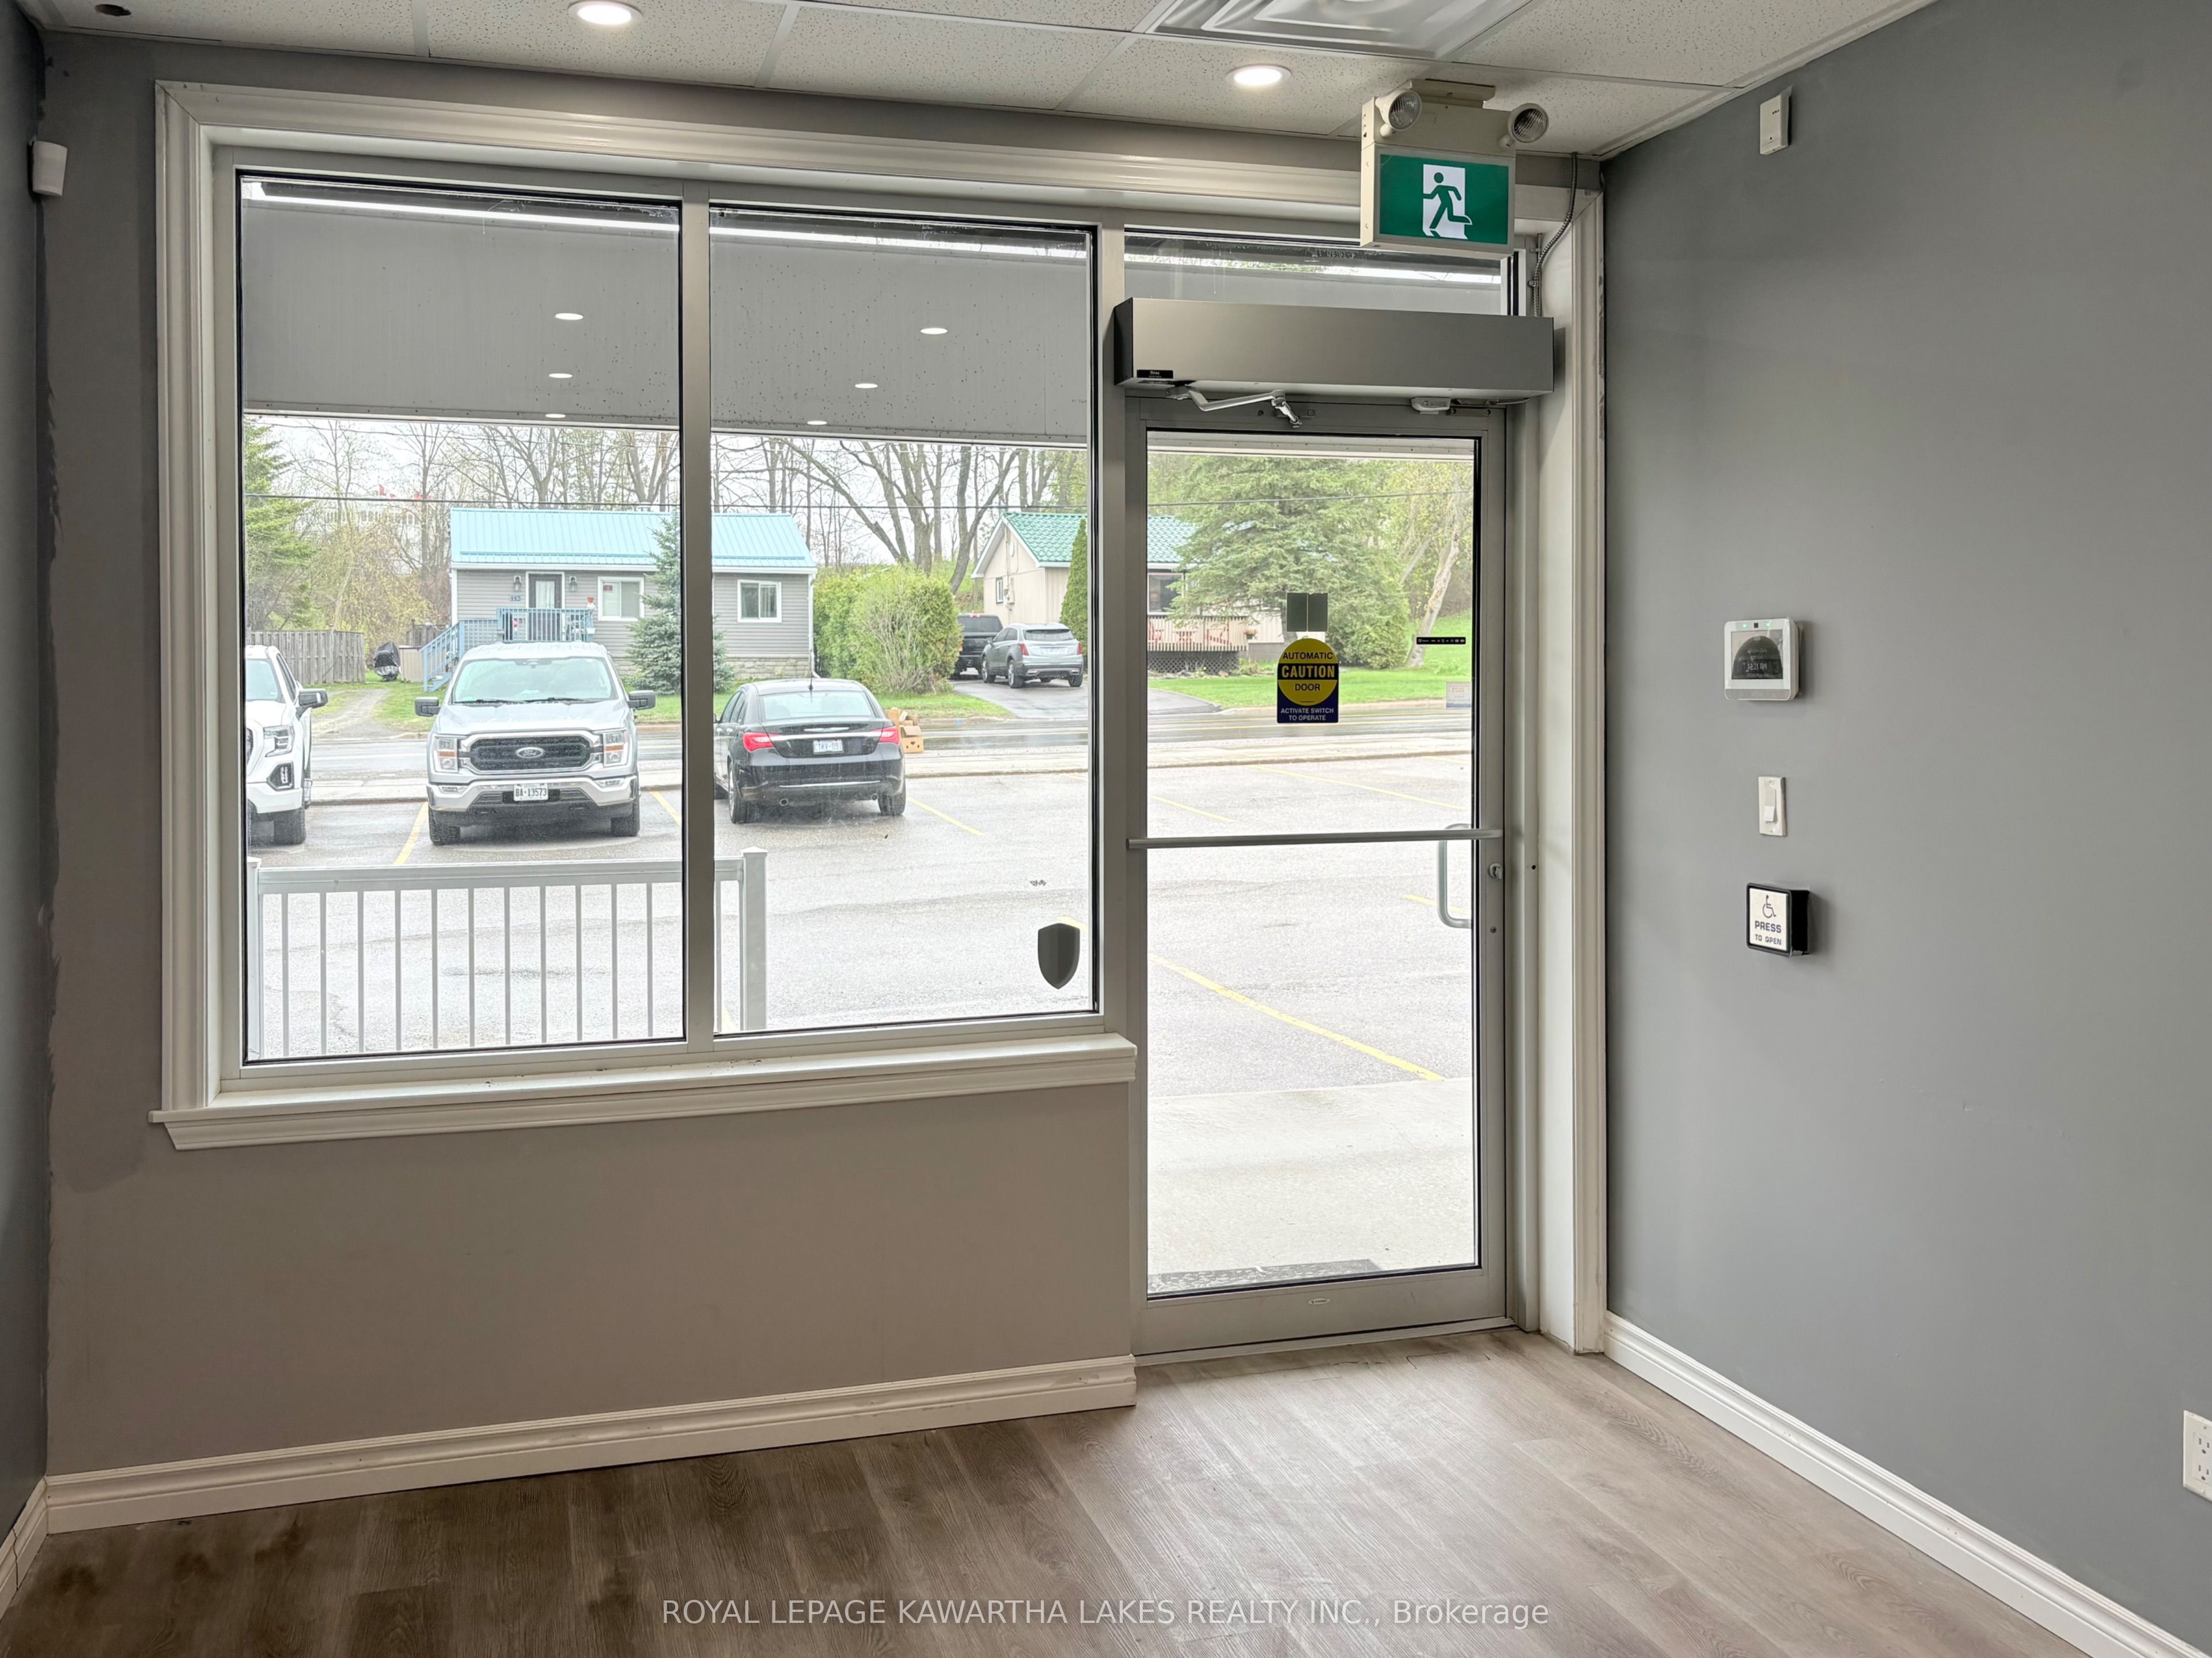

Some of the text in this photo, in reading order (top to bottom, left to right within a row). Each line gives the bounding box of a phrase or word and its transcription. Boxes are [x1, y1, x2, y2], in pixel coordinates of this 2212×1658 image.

[1281, 665, 1335, 678] CAUTION
[1294, 683, 1321, 691] DOOR
[1755, 920, 1782, 933] PRESS
[1765, 936, 1782, 945] OPEN
